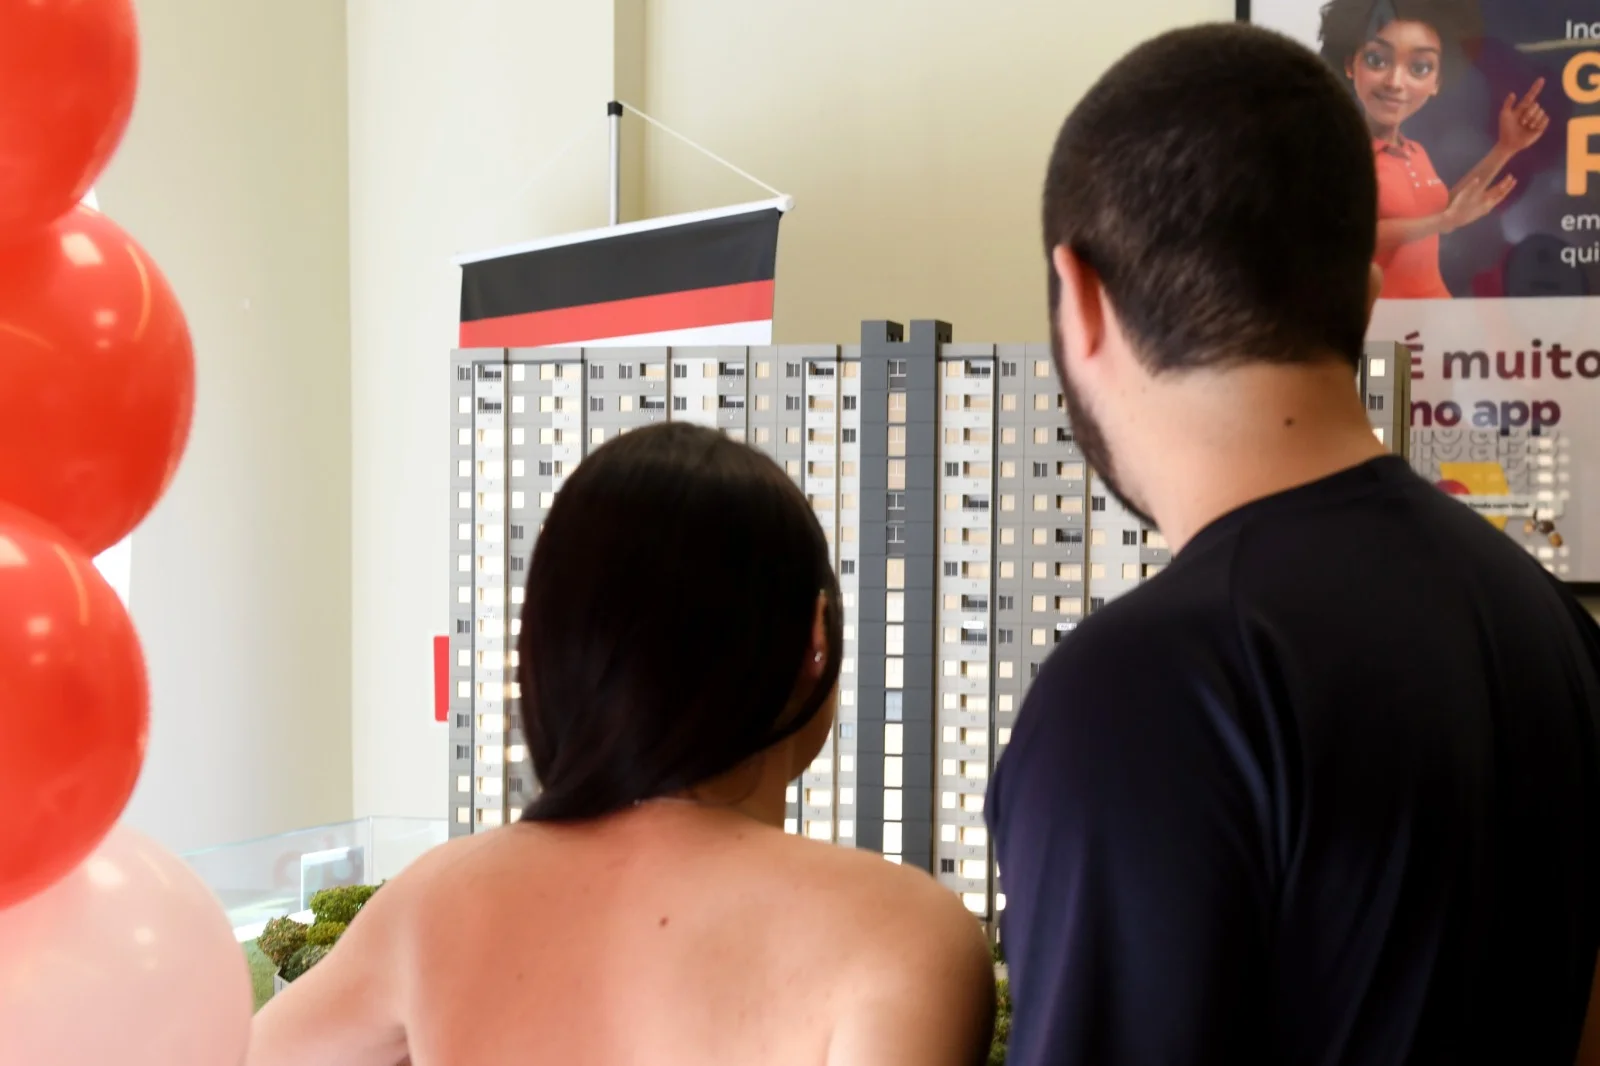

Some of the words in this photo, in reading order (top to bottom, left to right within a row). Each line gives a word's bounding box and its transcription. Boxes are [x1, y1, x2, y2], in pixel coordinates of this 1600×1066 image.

[1405, 331, 1424, 379] É
[1443, 339, 1600, 379] muito
[1410, 400, 1462, 427] no
[1472, 400, 1561, 436] app
